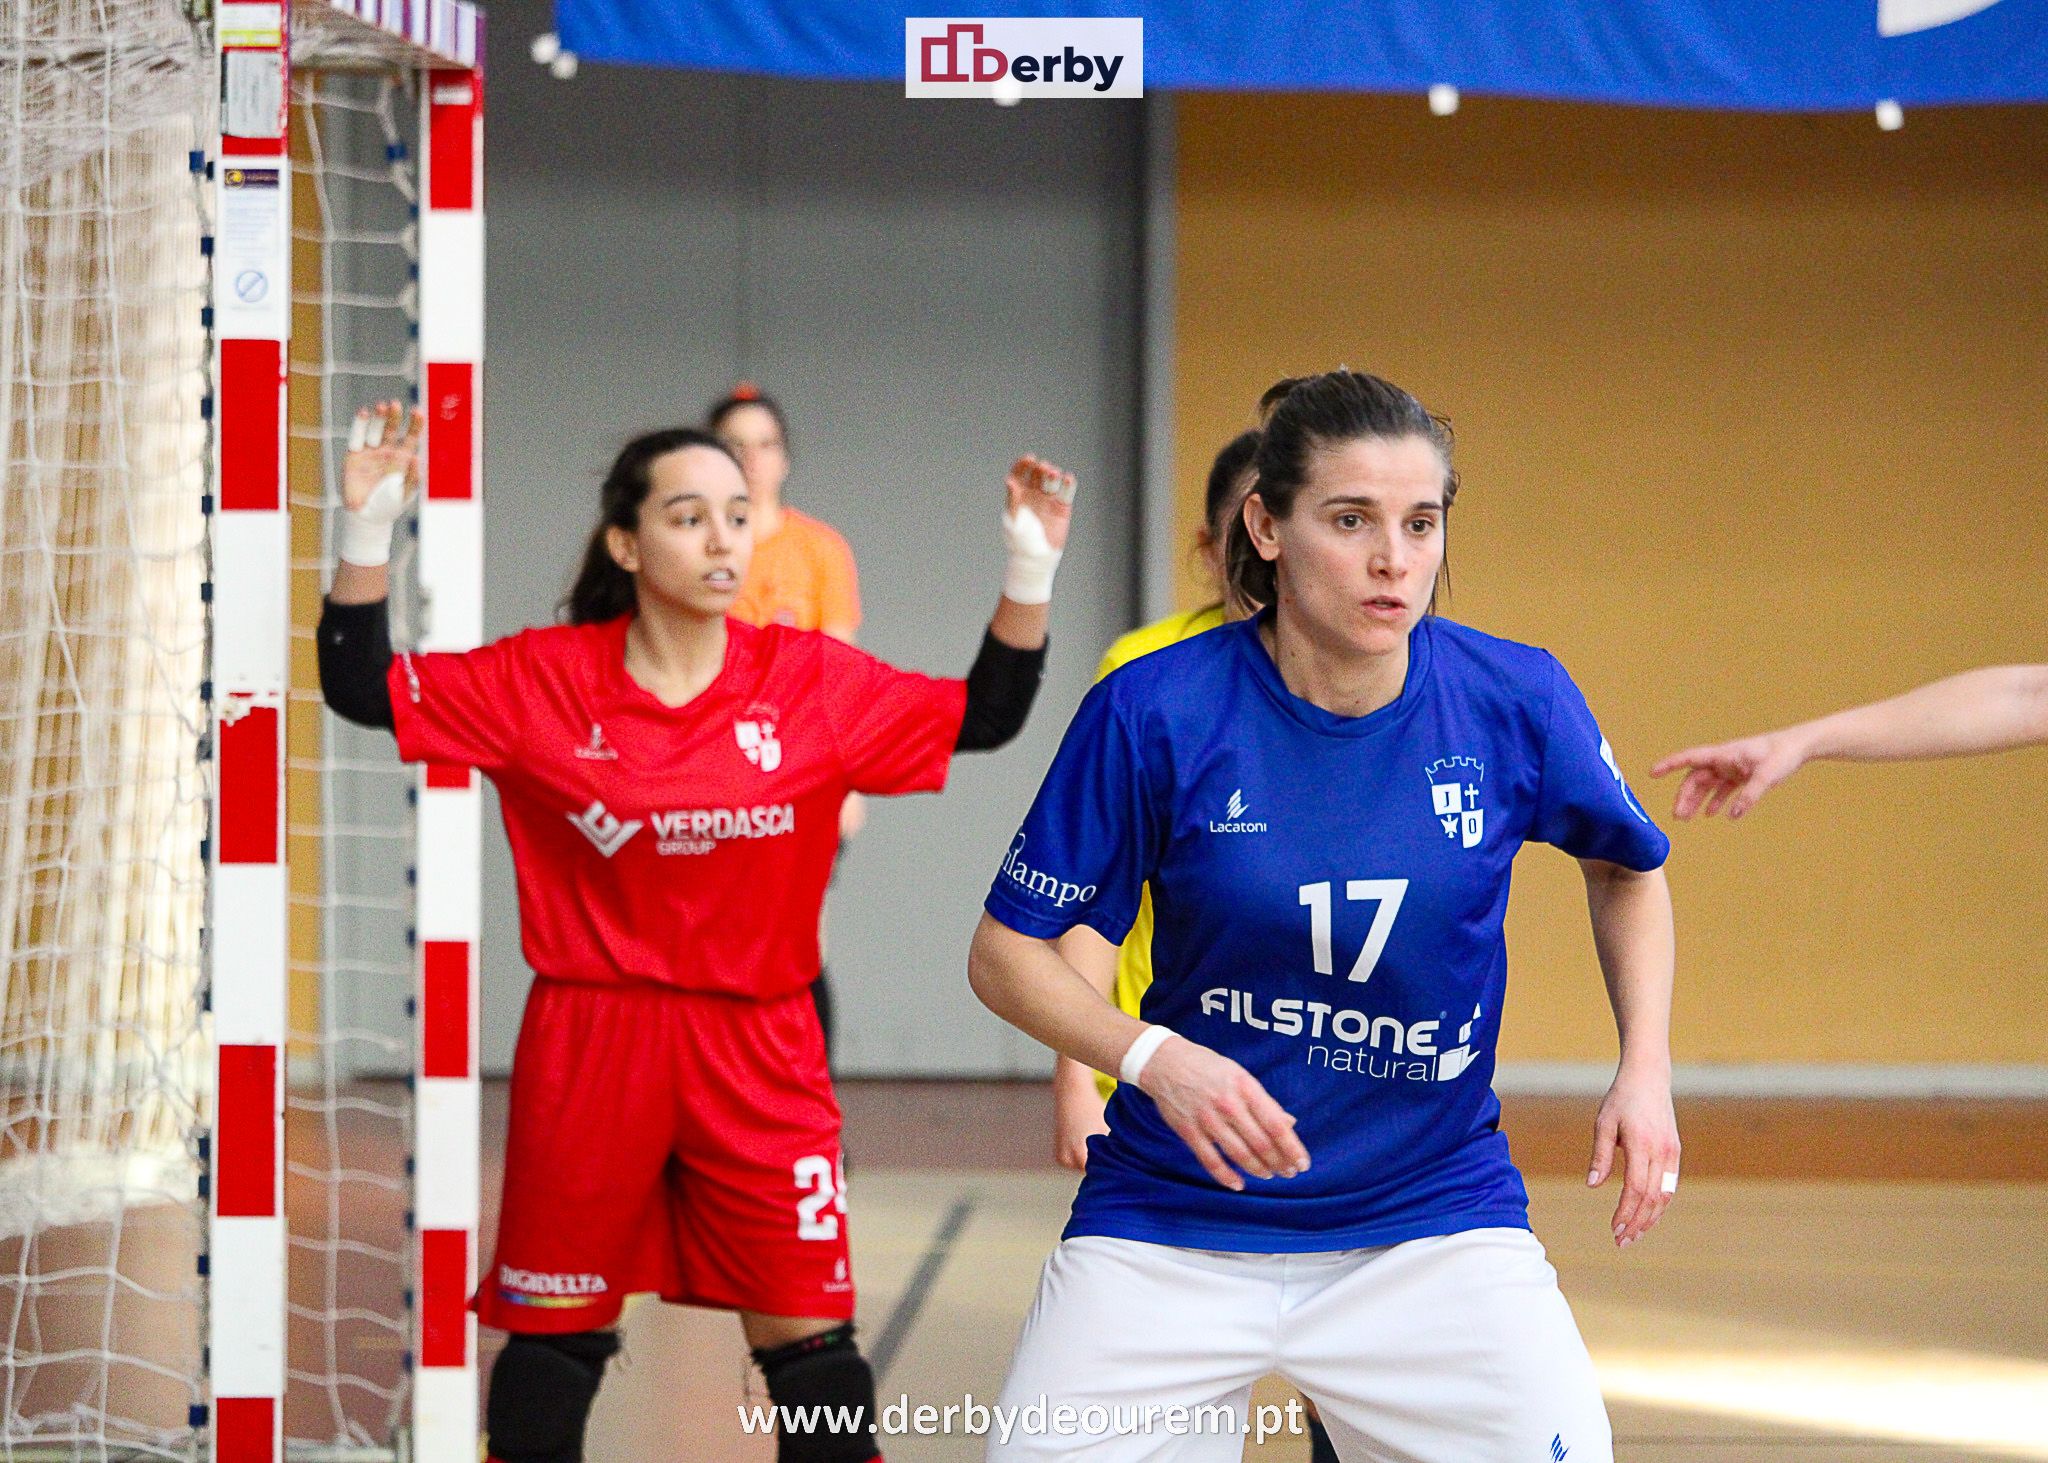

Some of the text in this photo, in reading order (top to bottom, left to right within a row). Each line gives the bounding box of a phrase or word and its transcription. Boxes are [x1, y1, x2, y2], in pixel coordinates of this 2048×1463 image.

[651, 803, 795, 839] VERDASCA
[1209, 820, 1267, 834] Lacatoni
[1299, 878, 1410, 983] 17
[1200, 988, 1440, 1056] FILSTONE
[1307, 1045, 1437, 1082] natural
[793, 1154, 848, 1241] 2
